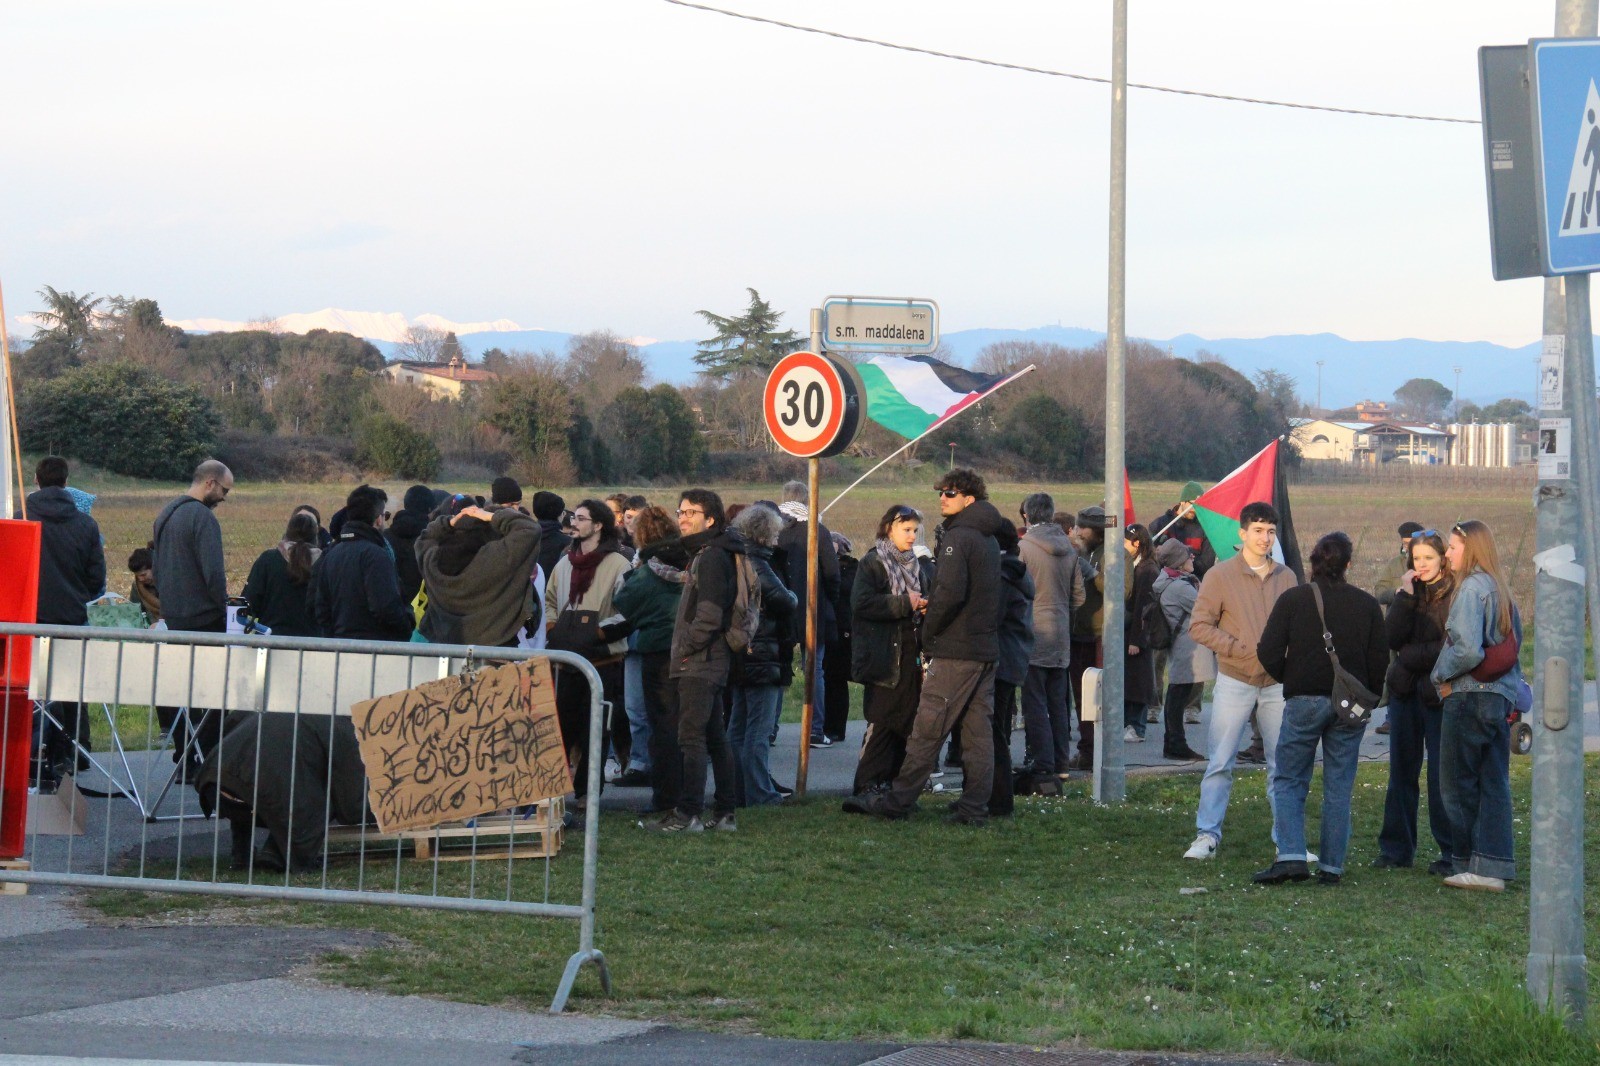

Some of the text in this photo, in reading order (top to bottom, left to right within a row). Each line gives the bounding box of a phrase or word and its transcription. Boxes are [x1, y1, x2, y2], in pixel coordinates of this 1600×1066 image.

[835, 324, 925, 340] s.m. maddalena
[780, 379, 825, 428] 30
